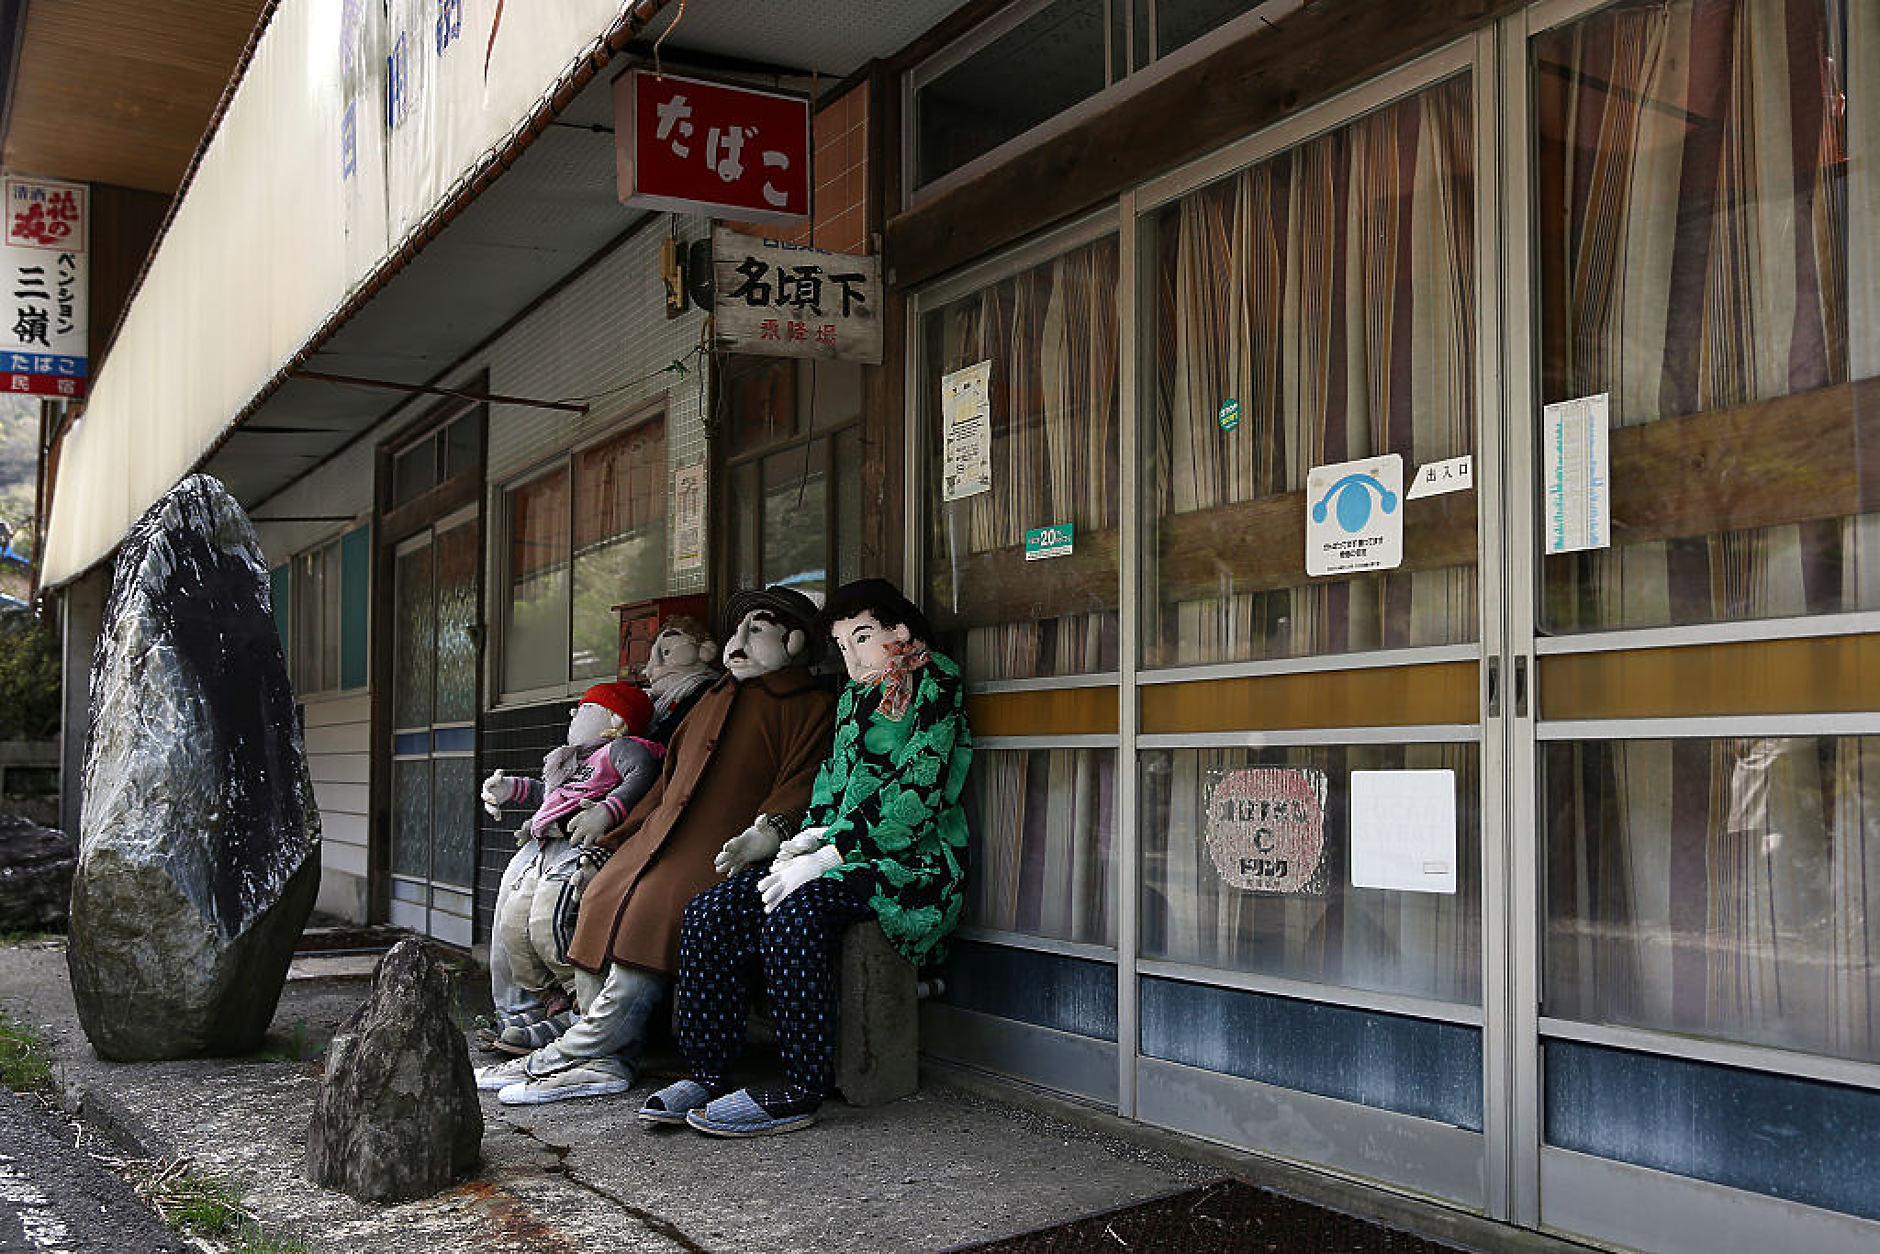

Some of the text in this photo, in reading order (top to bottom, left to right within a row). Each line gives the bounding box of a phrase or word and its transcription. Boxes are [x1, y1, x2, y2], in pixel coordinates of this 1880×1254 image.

[656, 94, 790, 207] たばこ
[728, 256, 868, 318] 名頃下
[1426, 464, 1467, 483] 出入口
[1253, 826, 1275, 854] C
